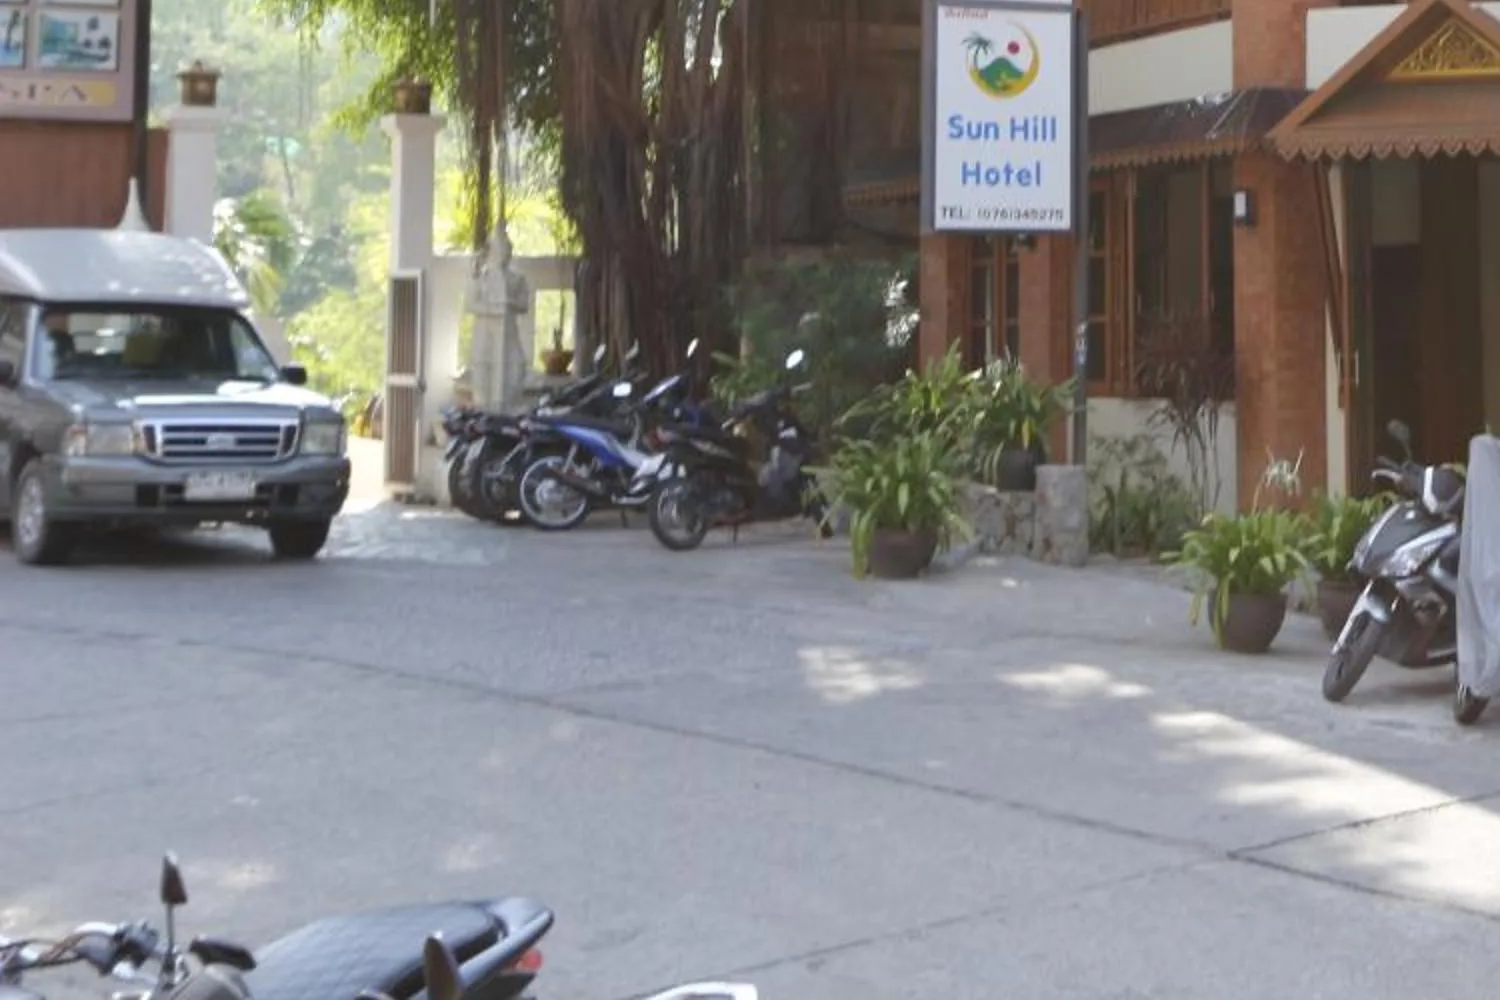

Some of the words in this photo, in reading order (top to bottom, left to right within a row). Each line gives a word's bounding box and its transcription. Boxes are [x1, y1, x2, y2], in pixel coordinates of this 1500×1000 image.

[947, 114, 999, 140] Sun
[1009, 115, 1056, 142] Hill
[961, 160, 1041, 187] Hotel
